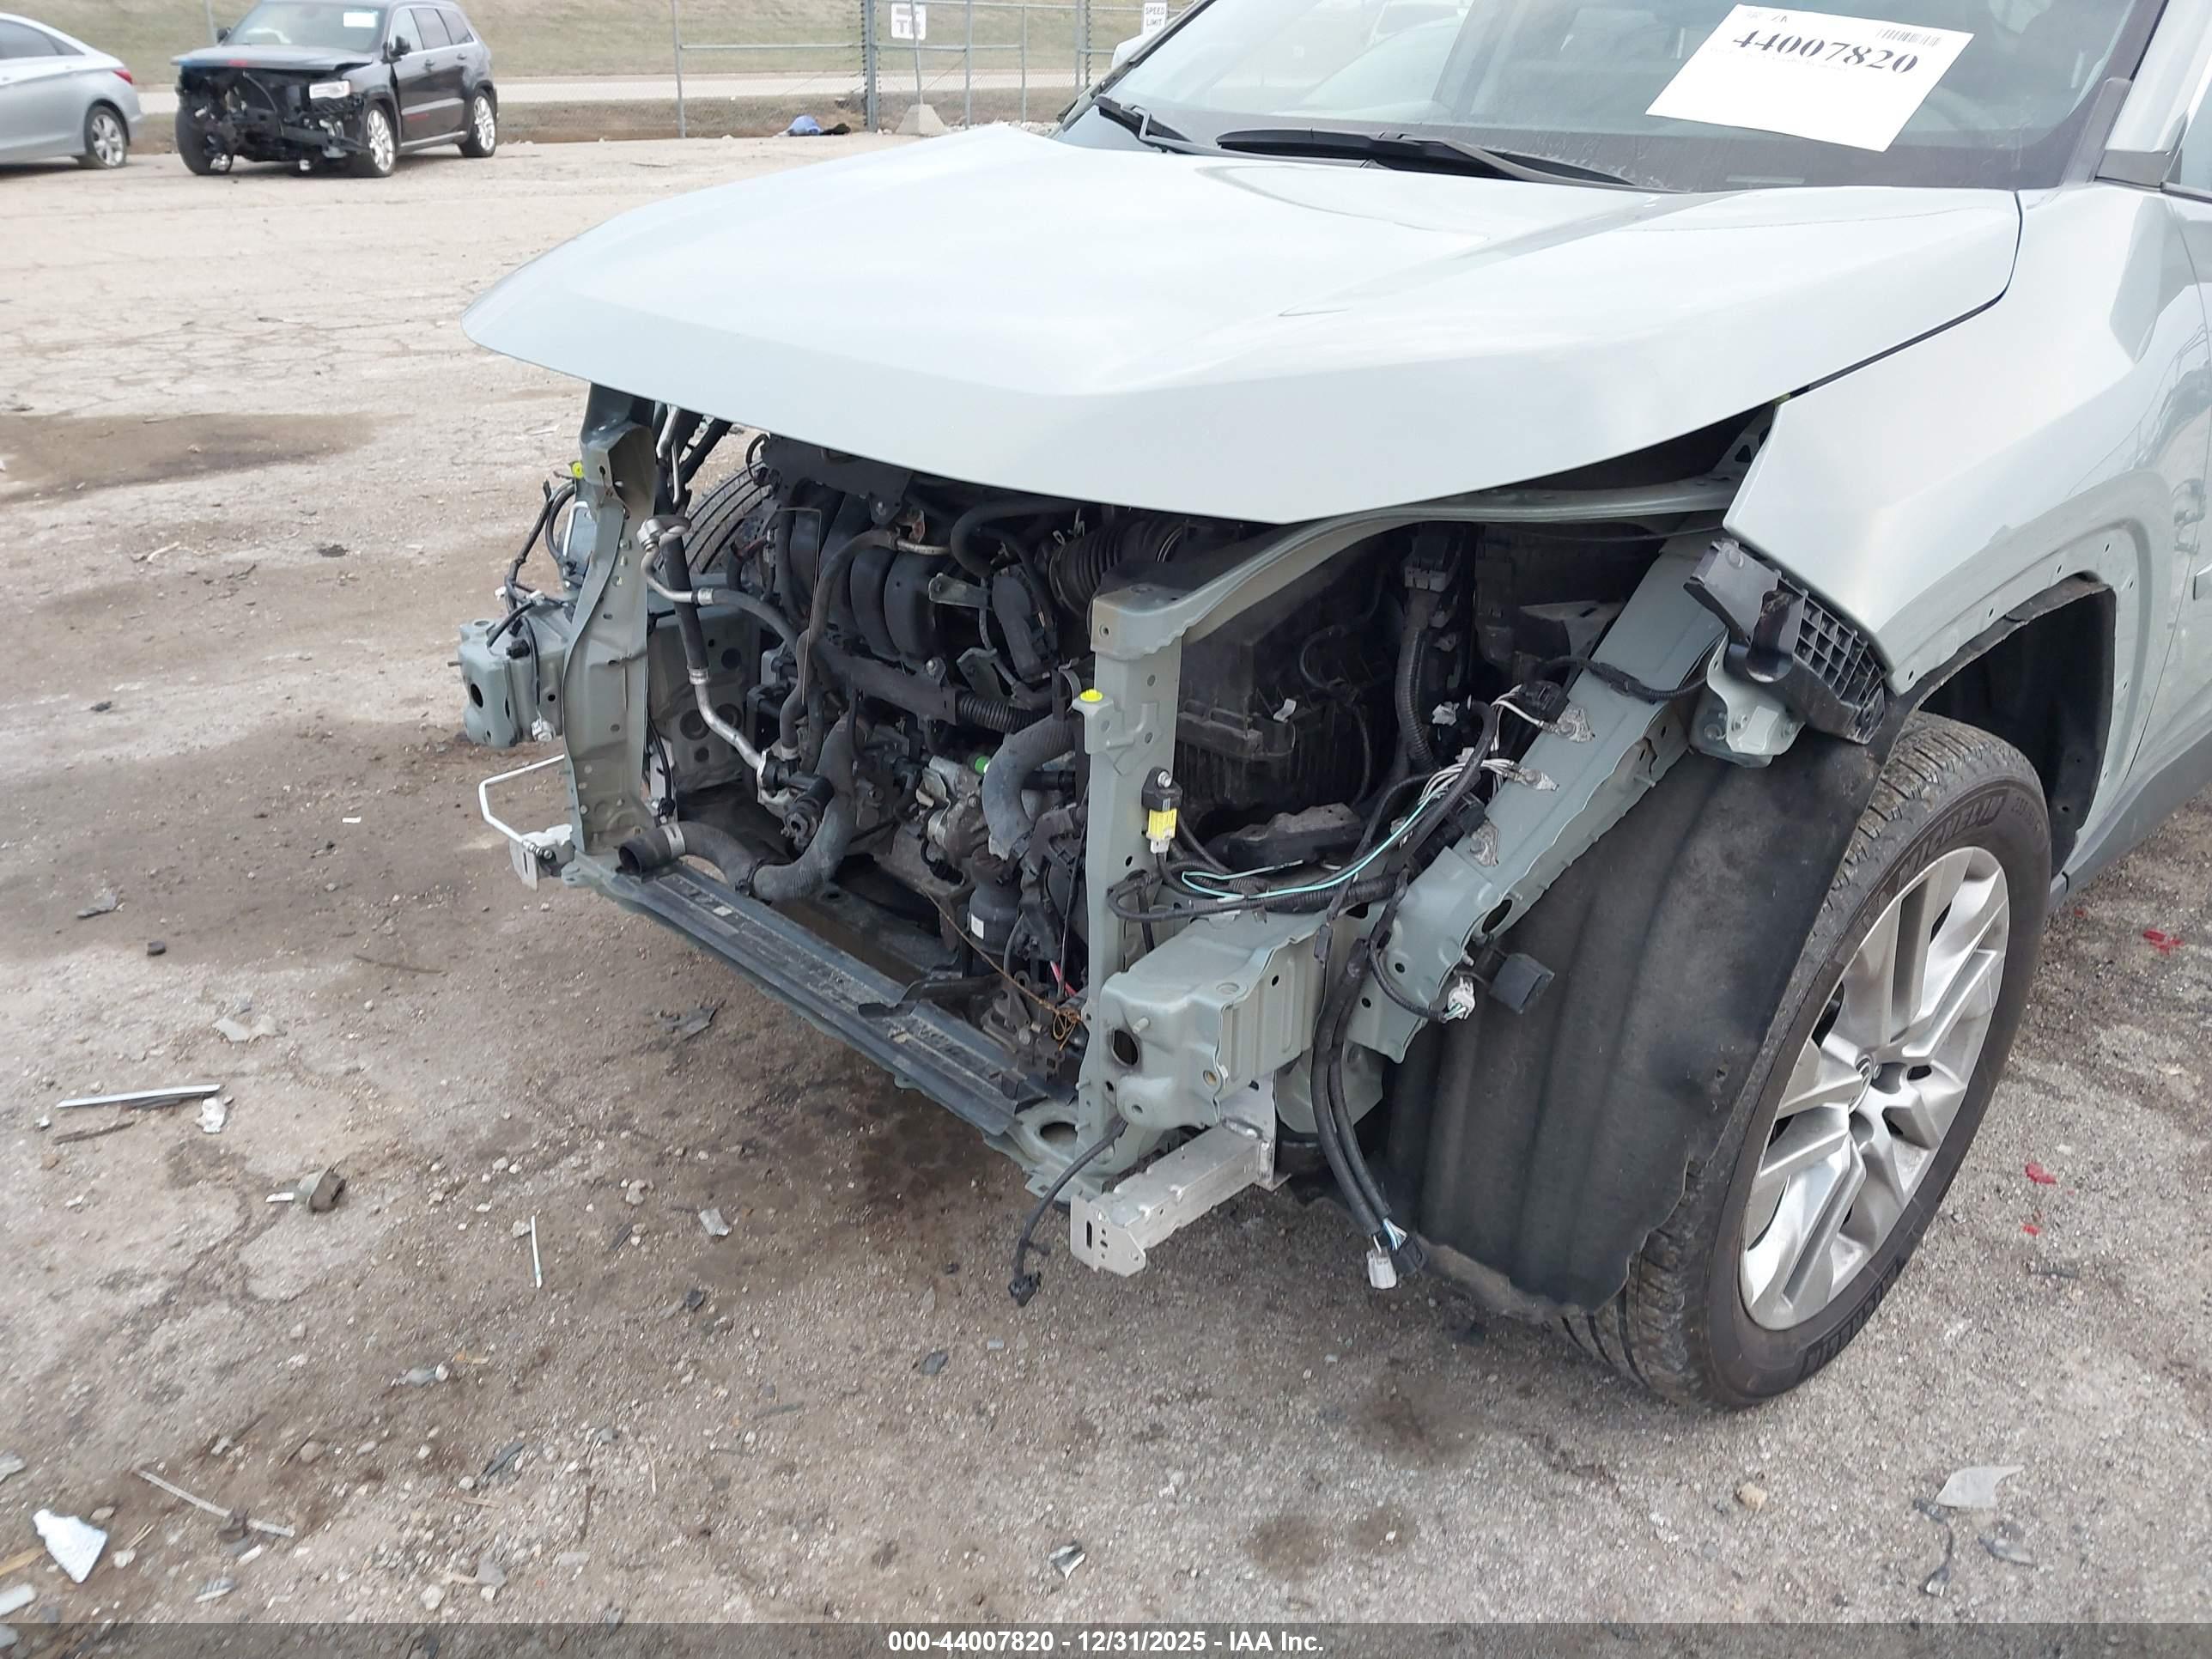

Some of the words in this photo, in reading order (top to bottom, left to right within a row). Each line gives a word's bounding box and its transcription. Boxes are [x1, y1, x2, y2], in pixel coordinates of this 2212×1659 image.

[1145, 6, 1165, 15] SPEED
[1146, 18, 1163, 27] LIMIT
[1732, 29, 1918, 74] 44007820
